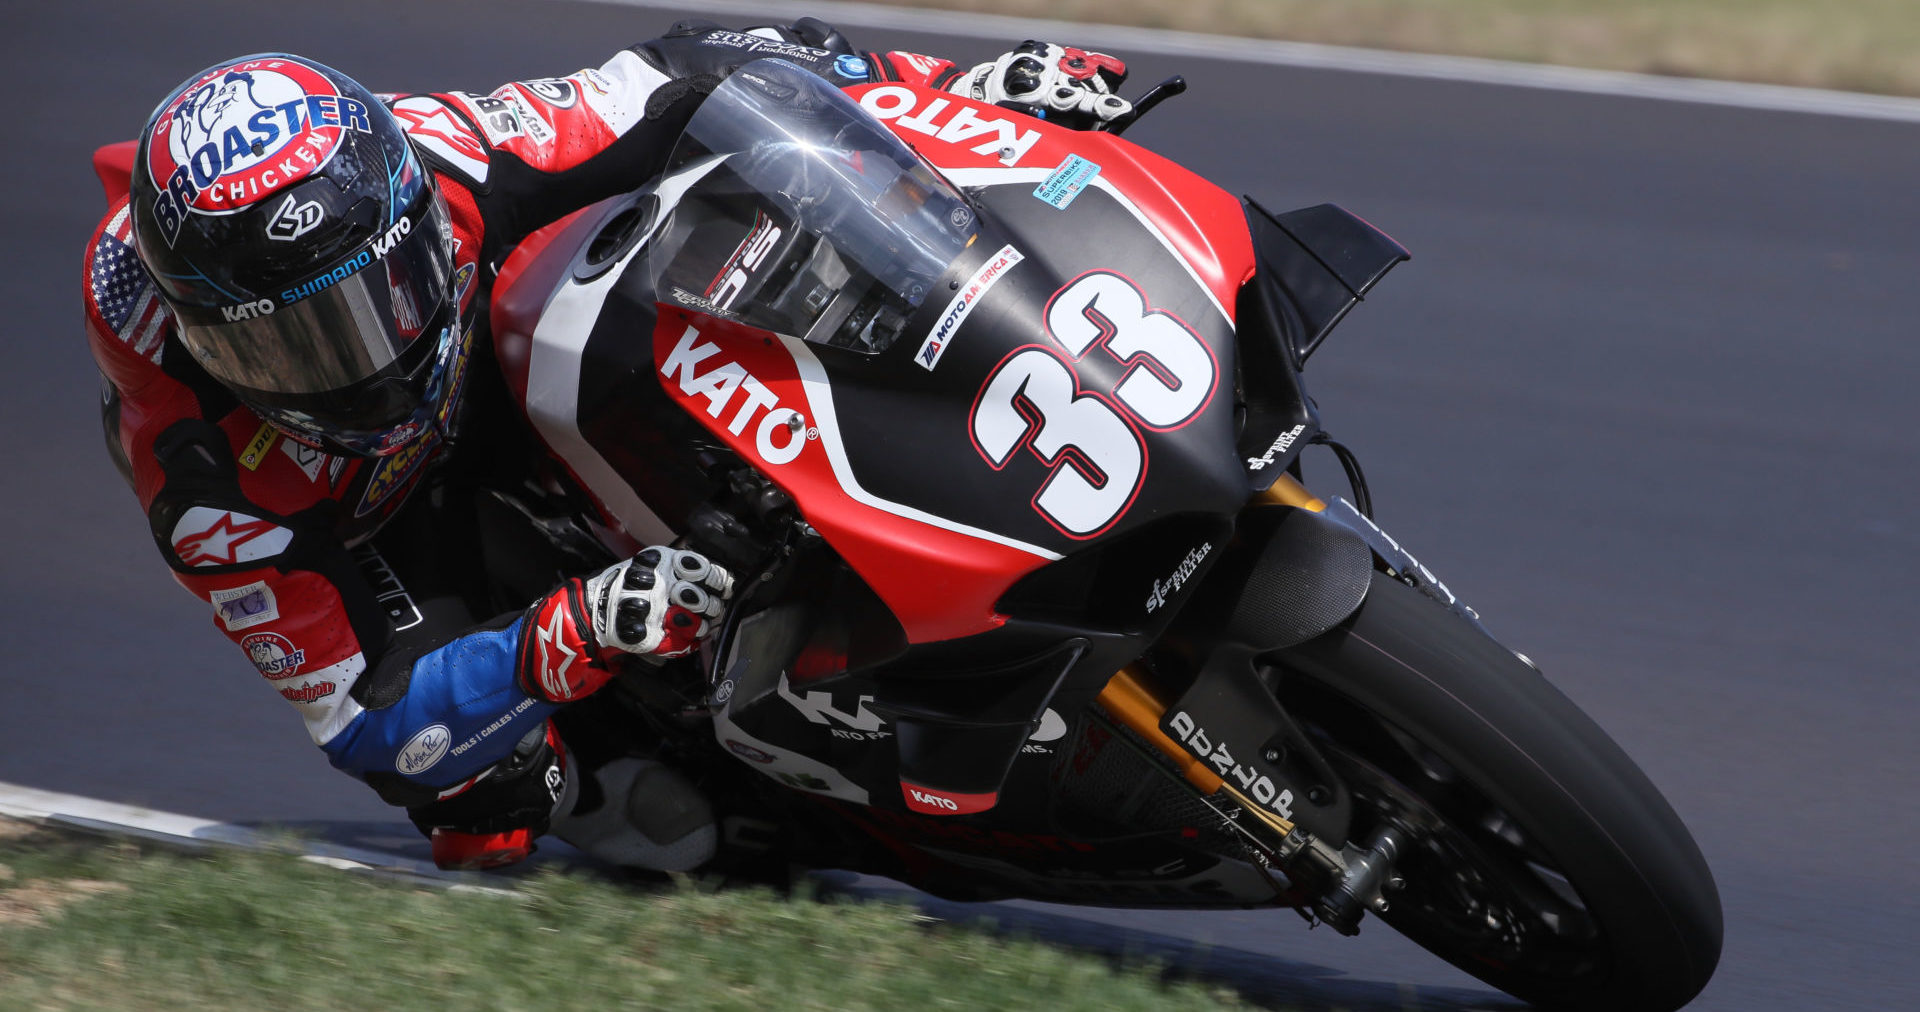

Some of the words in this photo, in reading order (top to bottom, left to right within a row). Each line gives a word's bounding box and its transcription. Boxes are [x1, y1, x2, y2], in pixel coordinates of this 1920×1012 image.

[757, 45, 818, 62] motorsport
[860, 86, 1042, 167] KATO
[153, 94, 372, 249] BROASTER
[209, 131, 328, 203] CHICKEN
[1042, 159, 1082, 198] SUPERBIKE
[1051, 189, 1068, 205] 2019
[221, 298, 275, 322] KATO
[280, 251, 371, 304] SHIMANO
[371, 216, 411, 259] KATO
[936, 256, 1010, 342] MOTOAMERICA
[660, 323, 807, 465] KATO
[968, 268, 1220, 541] 33
[213, 584, 259, 601] WEBSTER
[1160, 548, 1197, 594] SPRINT
[1174, 542, 1212, 592] FILTER
[450, 737, 477, 756] TOOLS
[481, 714, 512, 737] CABLES
[1170, 711, 1294, 821] DUNLOP
[910, 789, 958, 811] KATO
